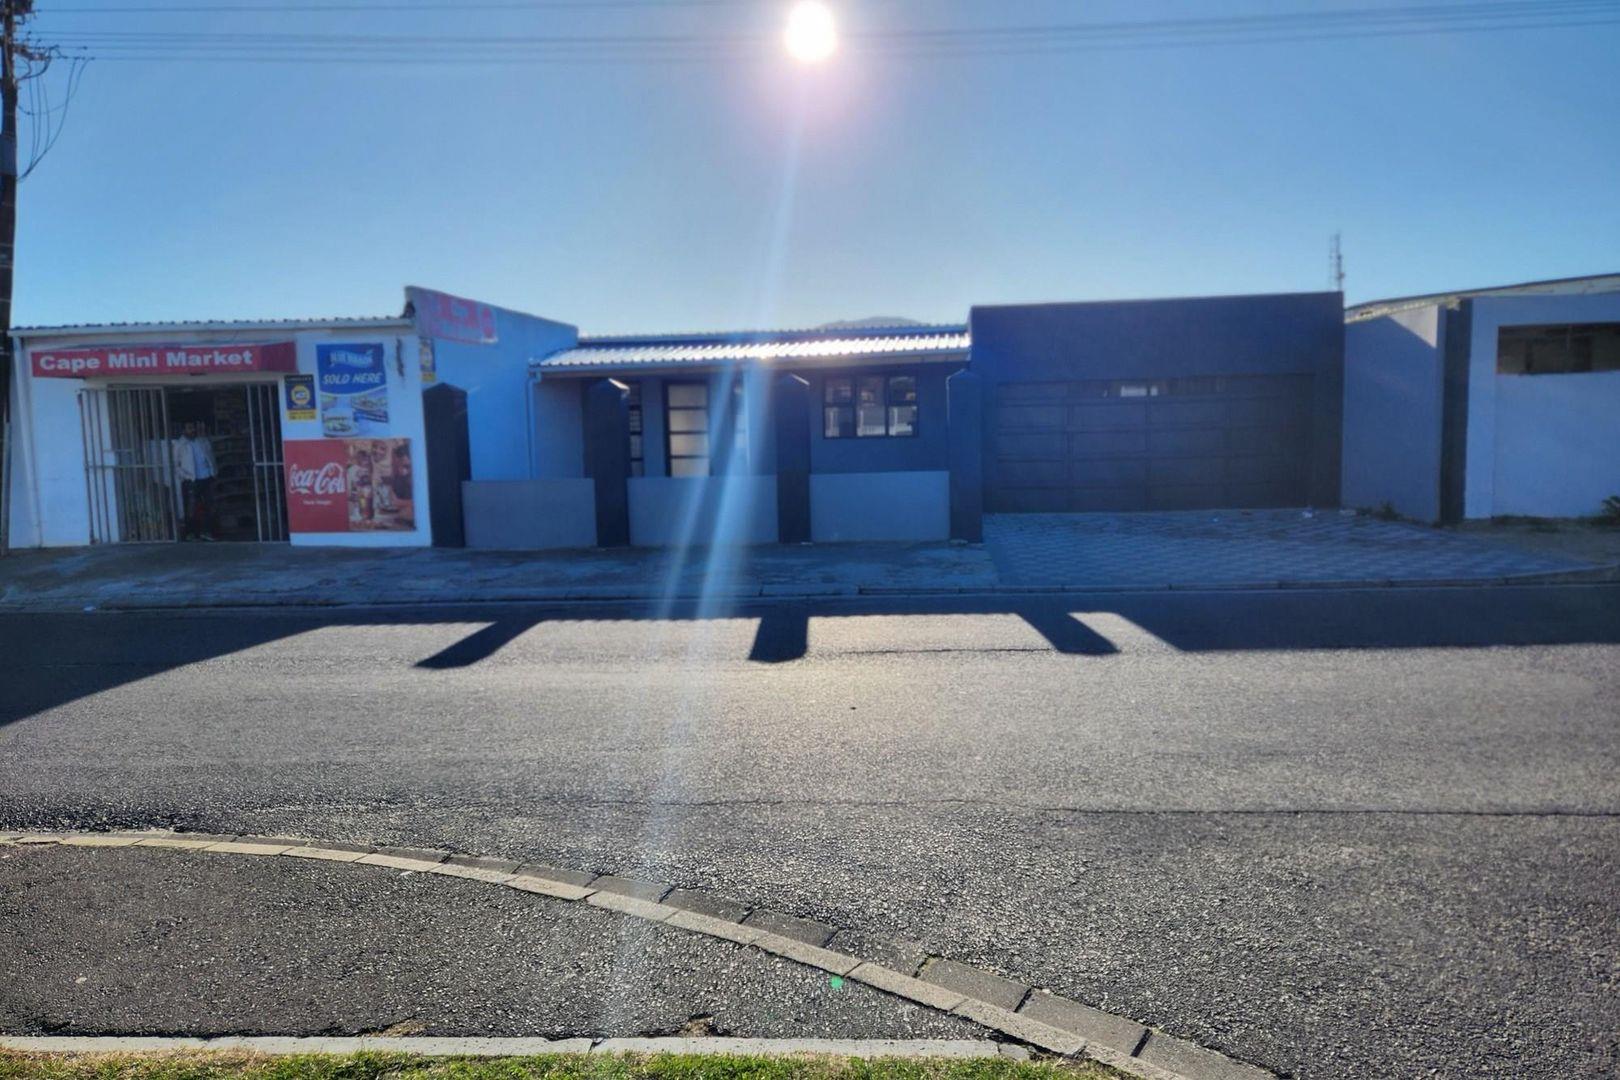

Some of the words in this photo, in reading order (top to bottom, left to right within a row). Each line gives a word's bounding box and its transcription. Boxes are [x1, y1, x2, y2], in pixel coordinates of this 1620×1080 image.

[39, 355, 101, 373] Cape
[108, 352, 158, 369] Mini
[166, 350, 253, 367] Market
[322, 374, 350, 385] SOLD
[352, 372, 383, 384] HERE
